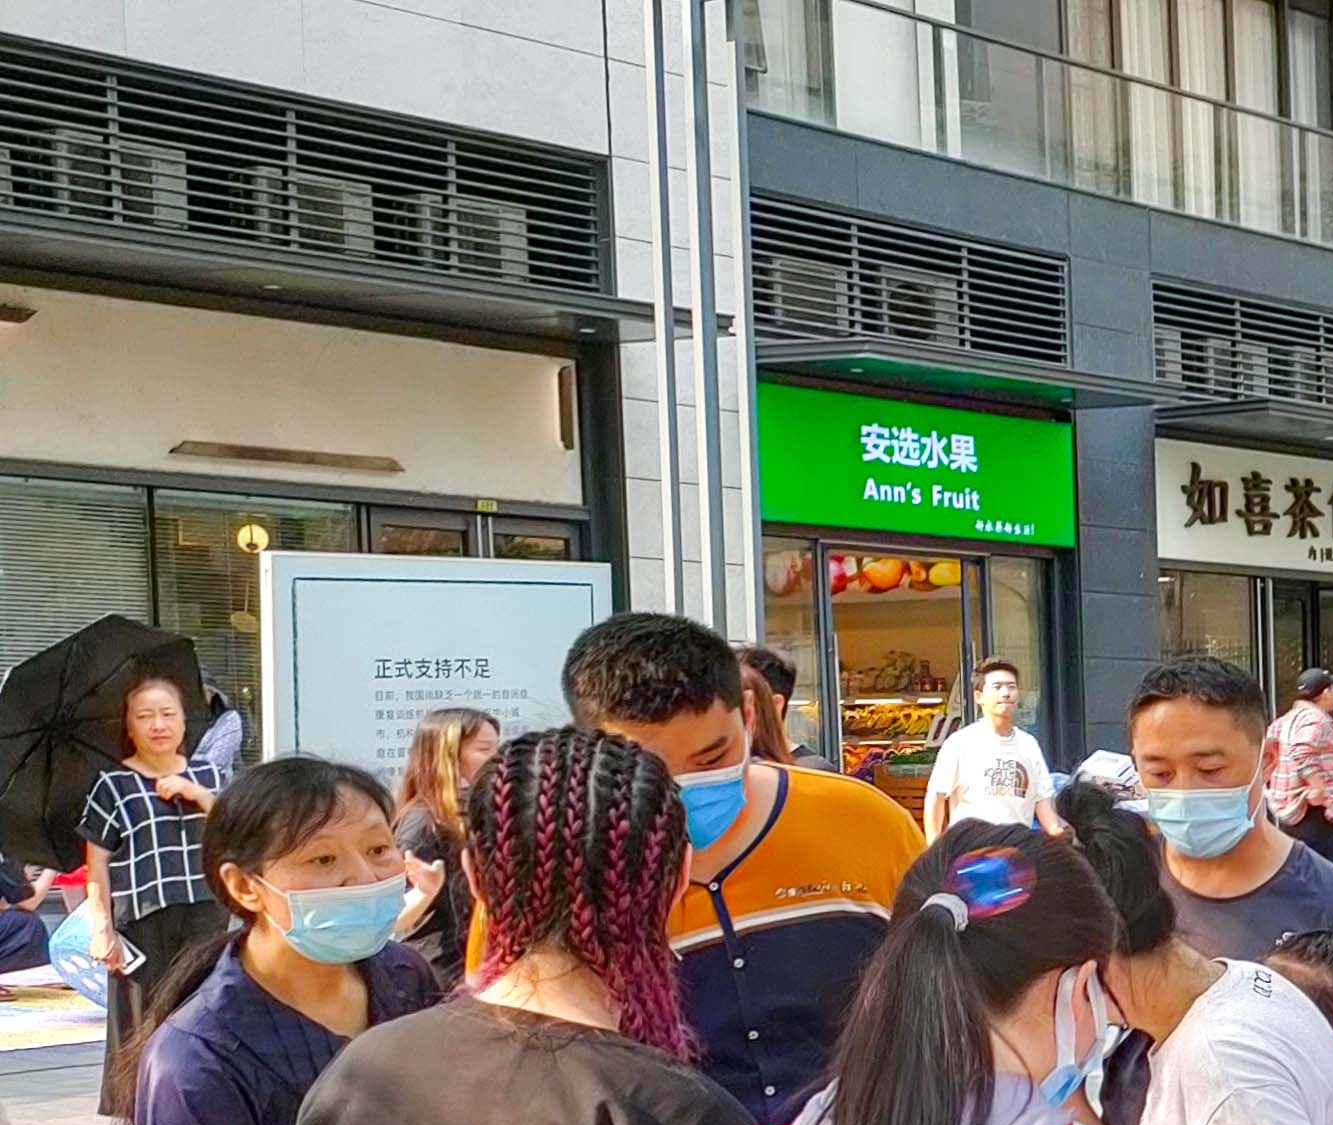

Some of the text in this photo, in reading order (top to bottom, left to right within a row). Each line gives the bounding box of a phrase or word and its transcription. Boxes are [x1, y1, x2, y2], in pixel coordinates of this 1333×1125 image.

[861, 423, 978, 472] 安选水果
[863, 477, 980, 511] Ann's Fruit
[374, 658, 491, 680] 正式支持不足
